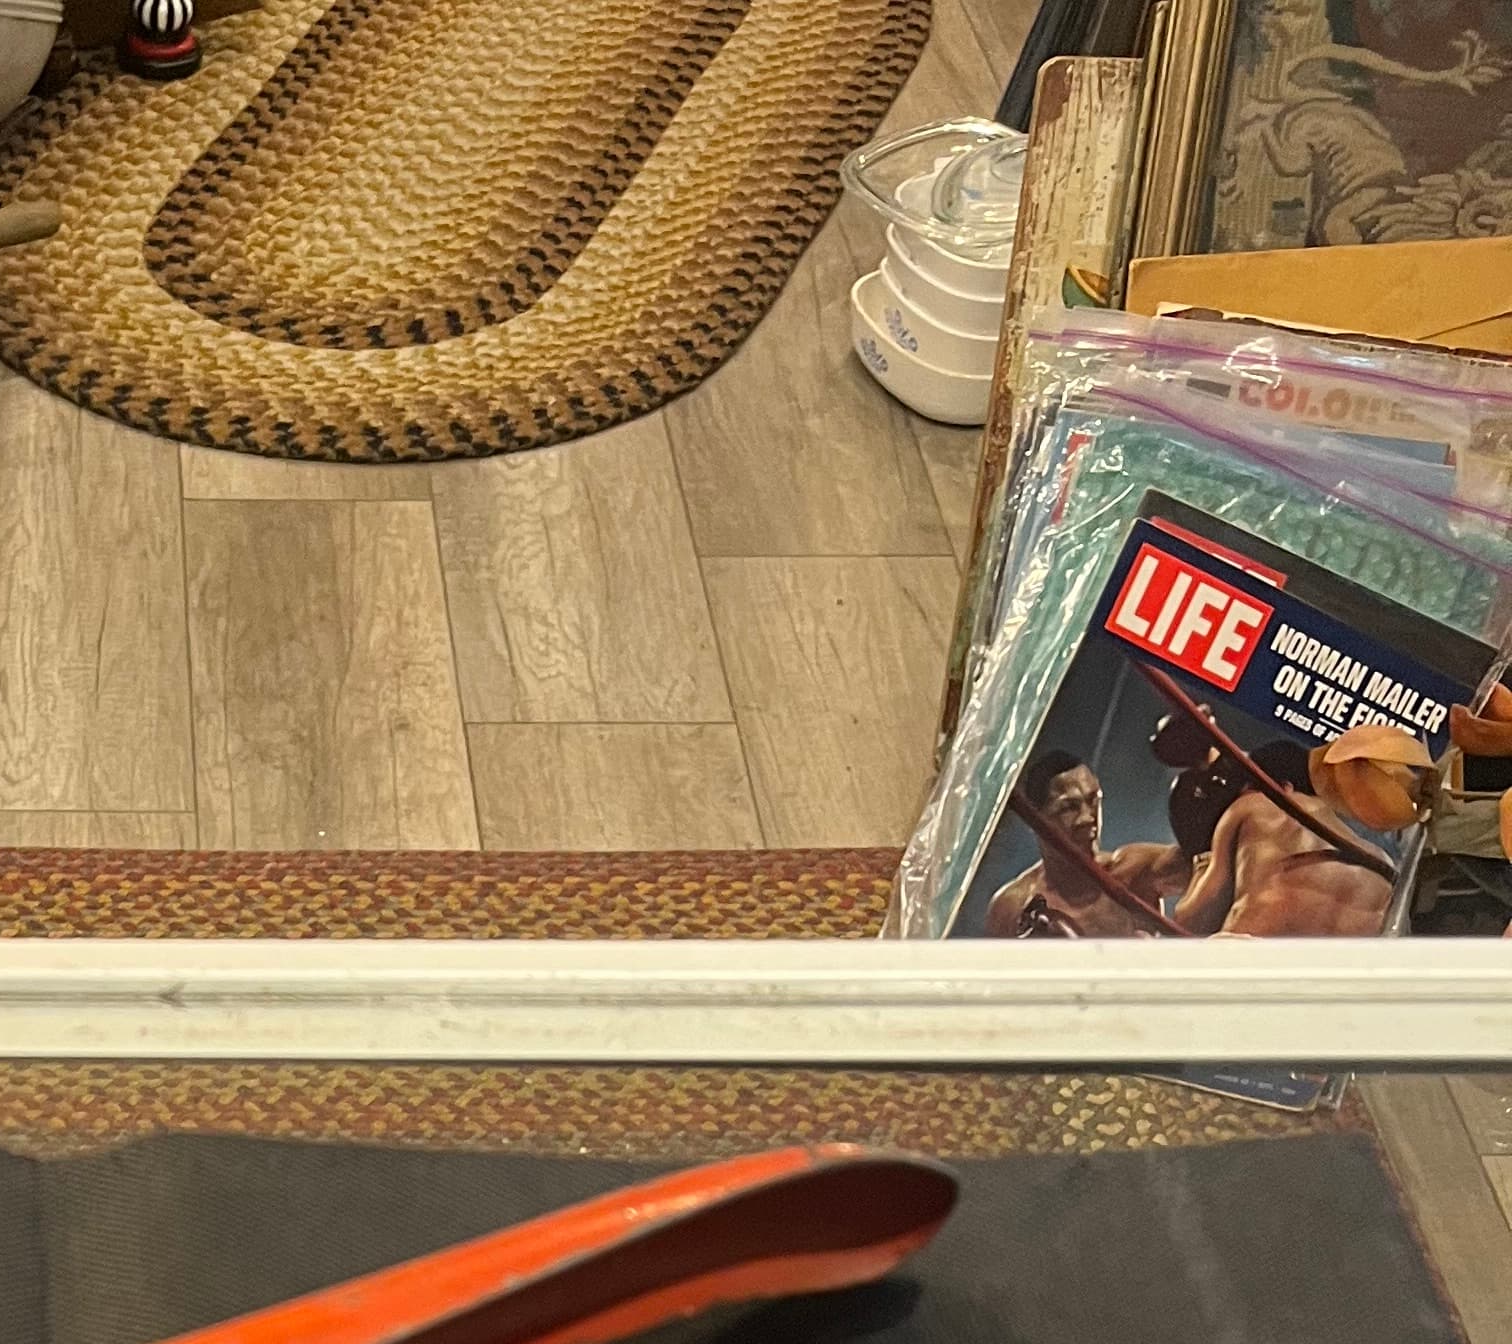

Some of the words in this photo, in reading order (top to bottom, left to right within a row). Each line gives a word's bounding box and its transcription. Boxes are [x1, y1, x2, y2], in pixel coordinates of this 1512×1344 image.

[1115, 554, 1264, 682] LIFE
[1270, 623, 1369, 693] NORMAN
[1362, 671, 1448, 735] MAILER
[1273, 665, 1311, 702] ON
[1308, 680, 1354, 723] THE
